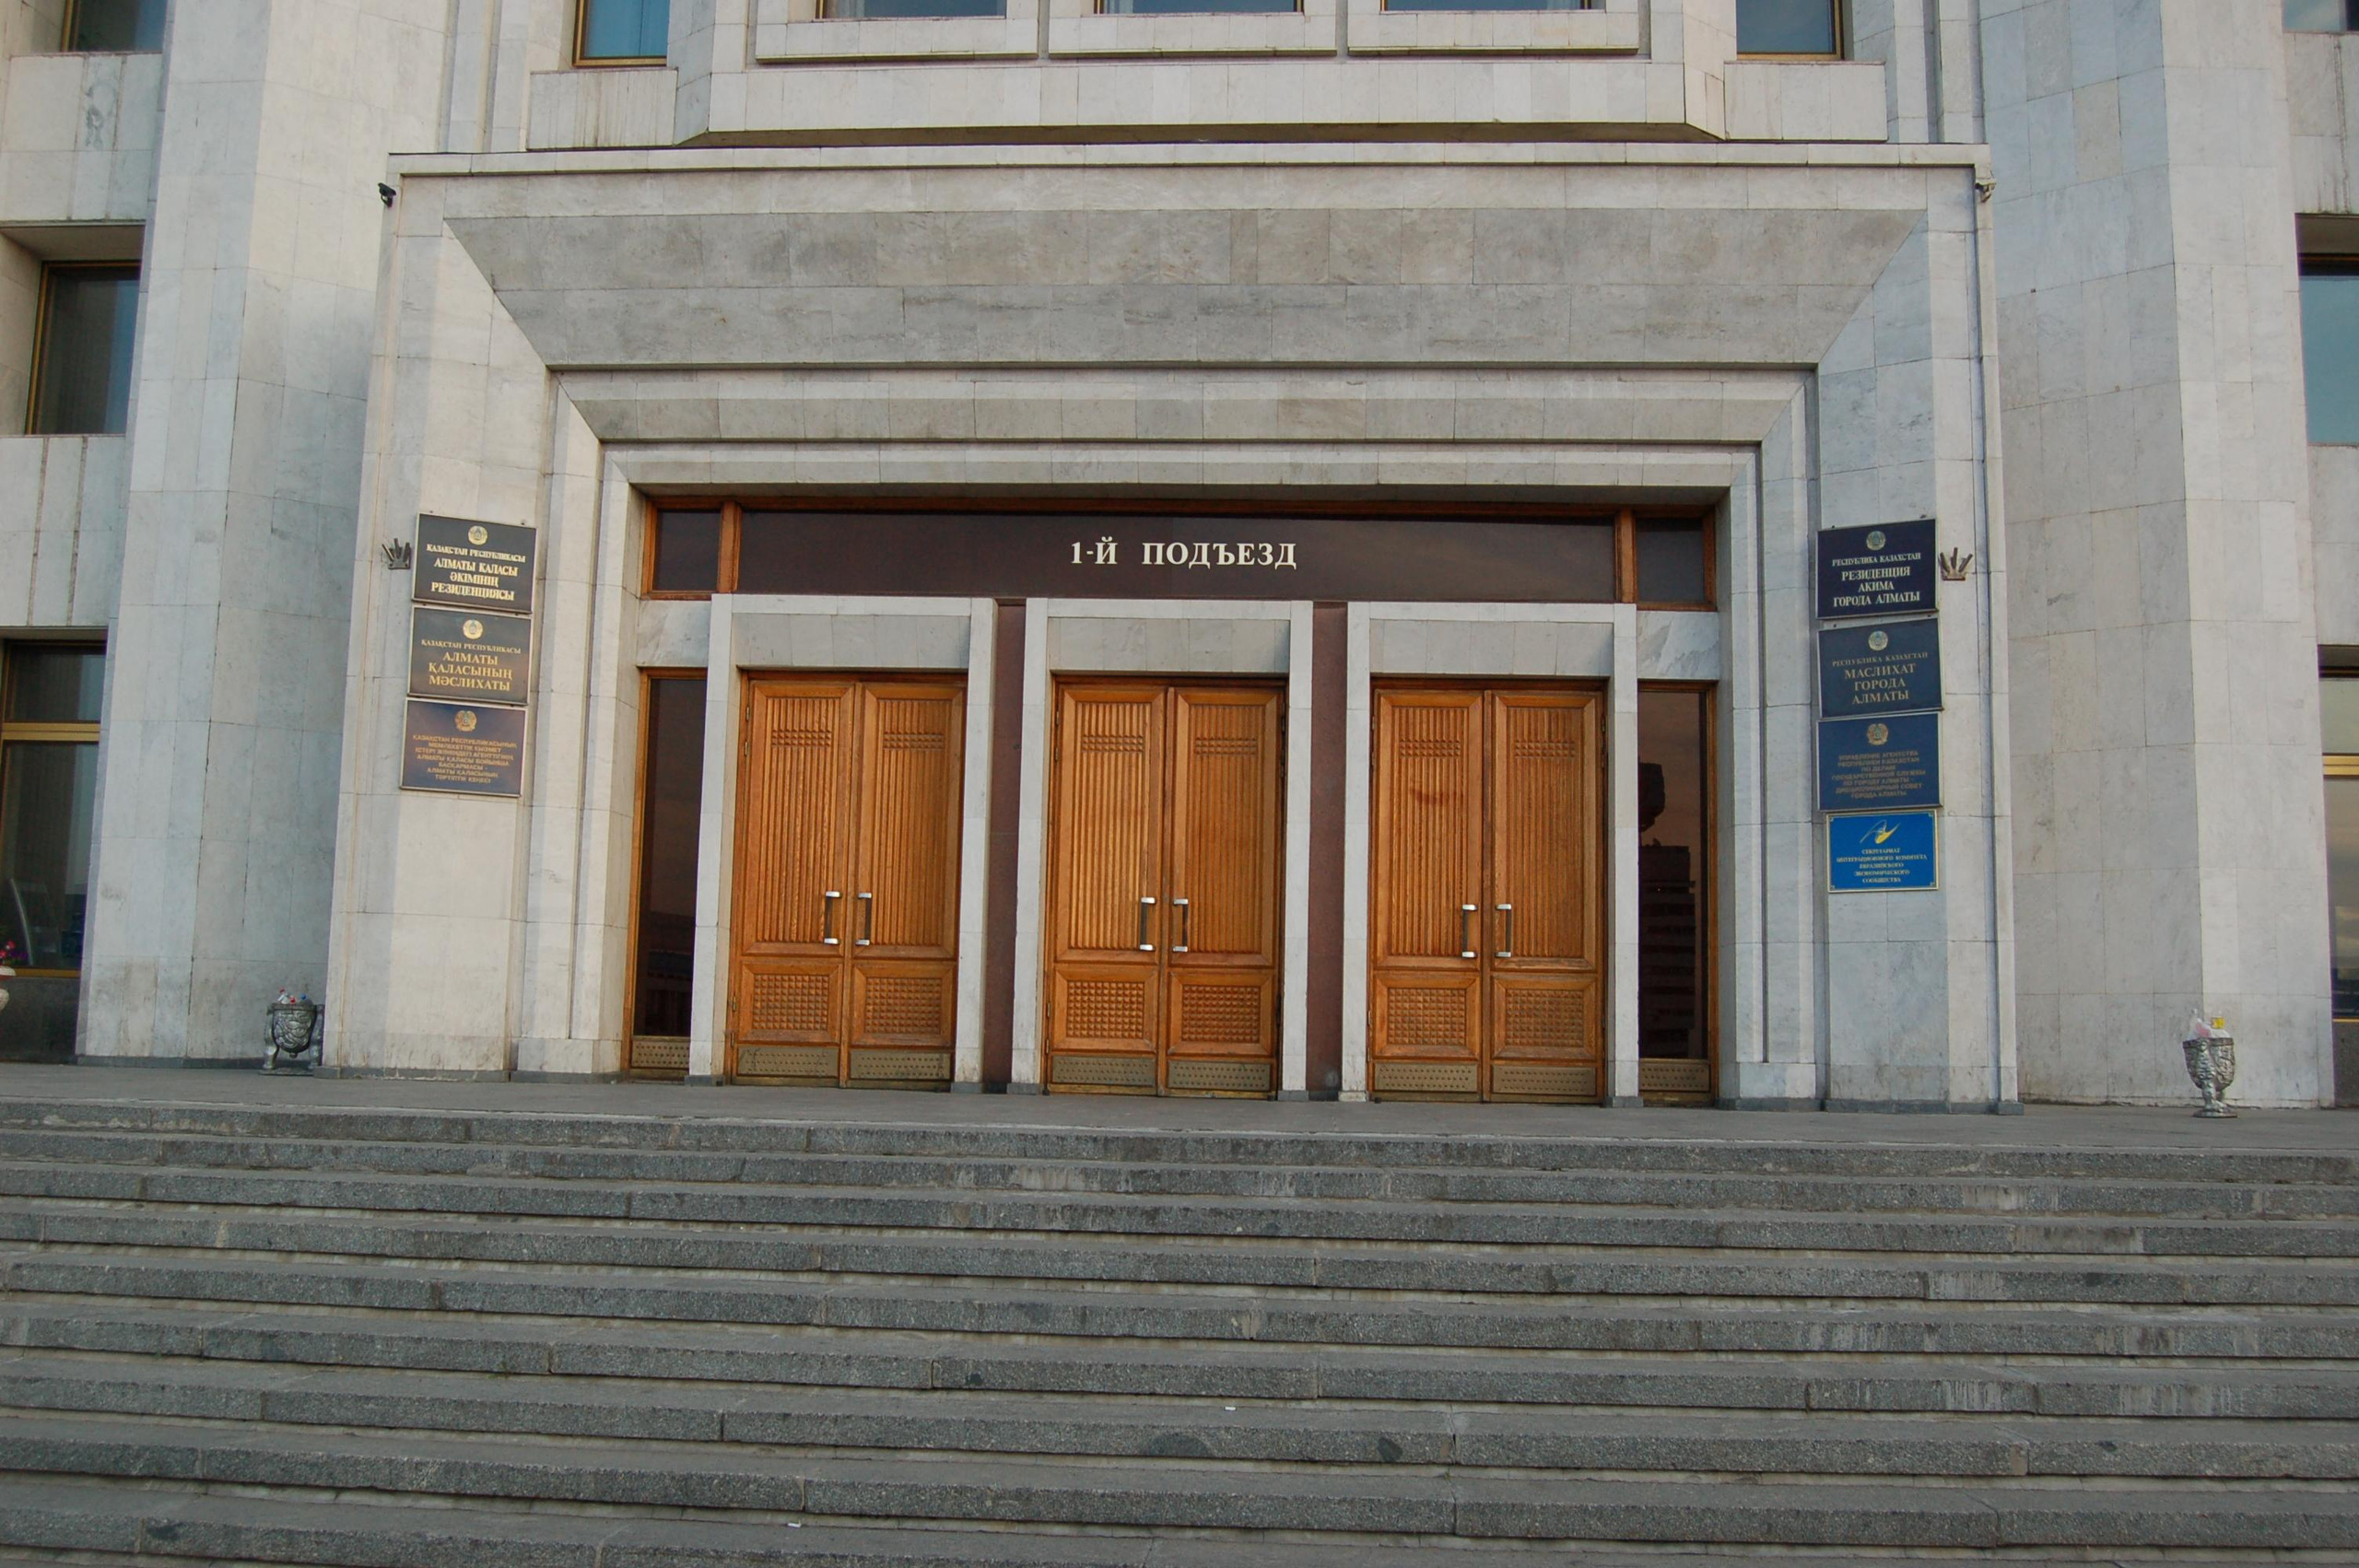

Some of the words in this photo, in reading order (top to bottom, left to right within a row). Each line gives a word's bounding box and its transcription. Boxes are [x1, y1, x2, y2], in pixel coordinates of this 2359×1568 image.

[469, 548, 526, 563] РЕСПУБЛИКАСЫ
[1071, 536, 1119, 565] 1-Й
[1142, 542, 1297, 569] ПОДЪЕЗД
[1832, 556, 1877, 567] РЕСПУБЛИКА
[1879, 552, 1921, 562] КАЗАХСТАН
[434, 557, 475, 571] АЛМАТЫ
[450, 571, 499, 588] ӘКІМІНІҢ
[1841, 566, 1910, 581] РЕЗИДЕНЦИЯ
[431, 582, 515, 601] РЕЗИДЕНЦИЯСЫ
[1858, 580, 1895, 592] АКИМА
[1833, 595, 1872, 607] ГОРОДА
[1875, 591, 1920, 604] АЛМАТЫ
[464, 643, 522, 654] РЕСПУБЛИКАСЫ
[442, 650, 499, 665] АЛМАТЫ
[1832, 656, 1883, 667] РЕСПУБЛИКА
[1884, 651, 1929, 661] КАЗАХСТАН
[428, 662, 513, 681] ҚАЛАСЫНЫҢ
[1844, 662, 1917, 679] МАСЛИХАТ
[428, 674, 511, 692] МӘСЛИХАТЫ
[1854, 677, 1907, 692] ГОРОДА
[1852, 690, 1909, 705] АЛМАТЫ
